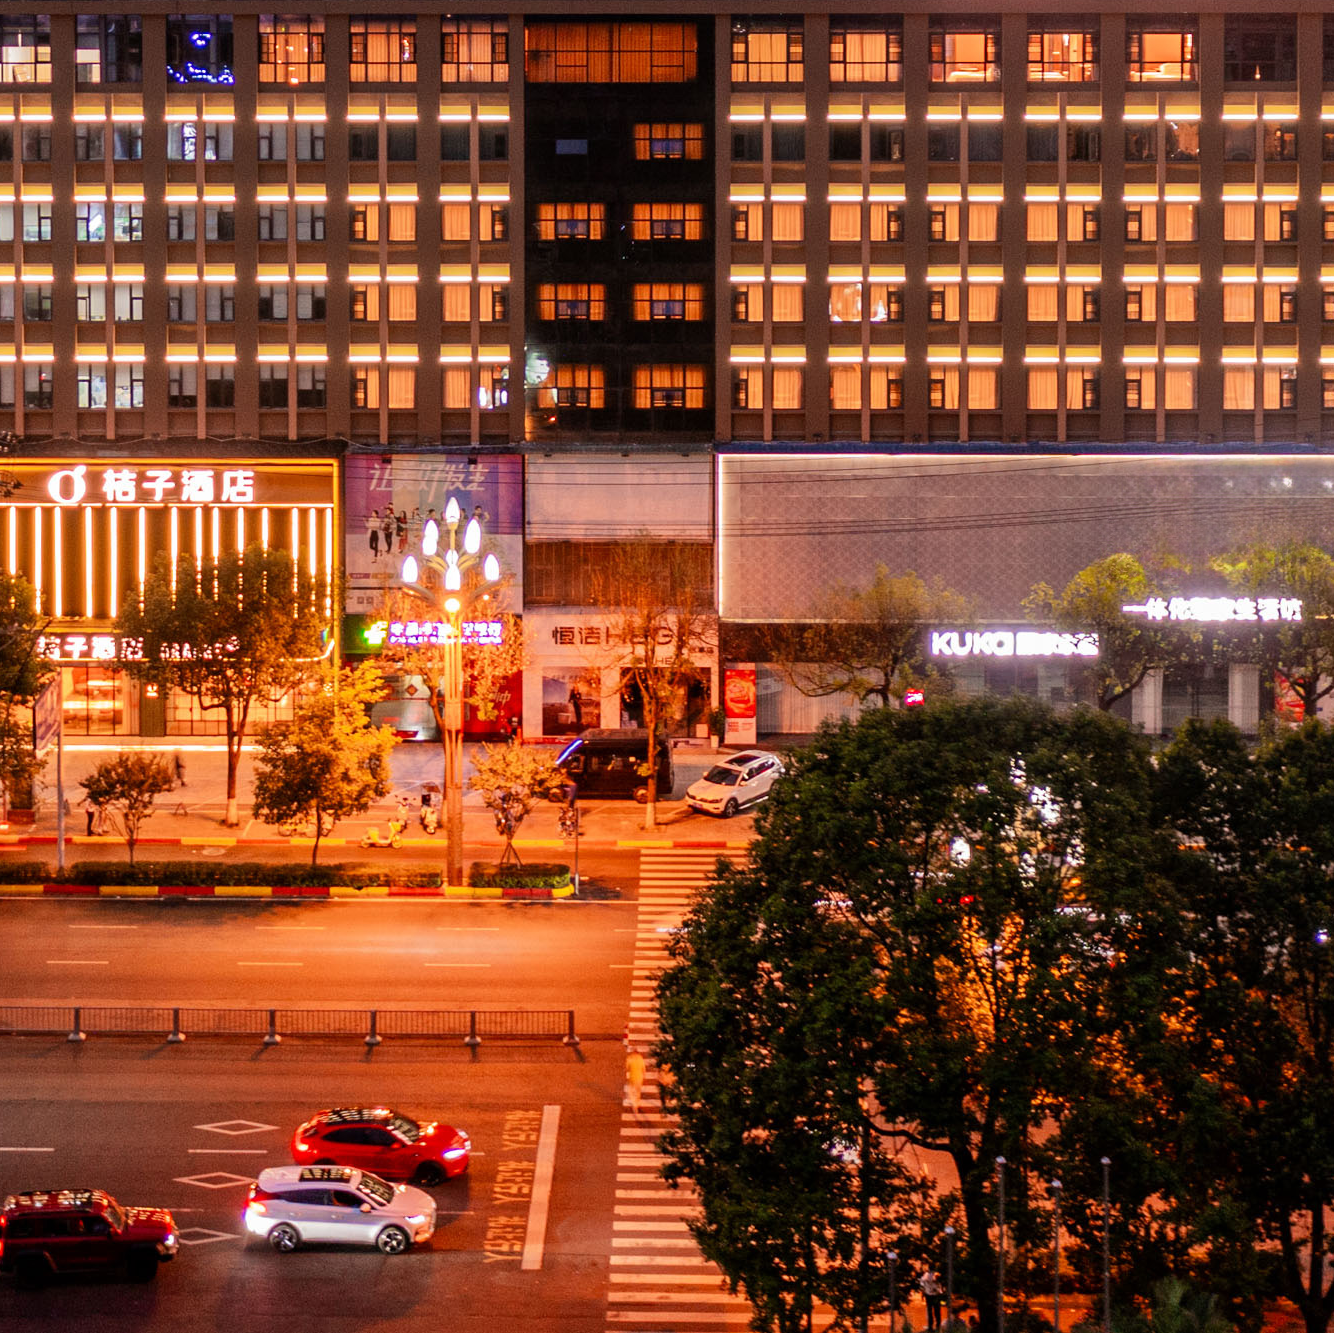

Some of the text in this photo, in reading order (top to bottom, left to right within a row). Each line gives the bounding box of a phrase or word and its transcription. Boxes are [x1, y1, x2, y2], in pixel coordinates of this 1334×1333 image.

[103, 469, 255, 503] 桔子酒店
[551, 626, 601, 646] 恒洁
